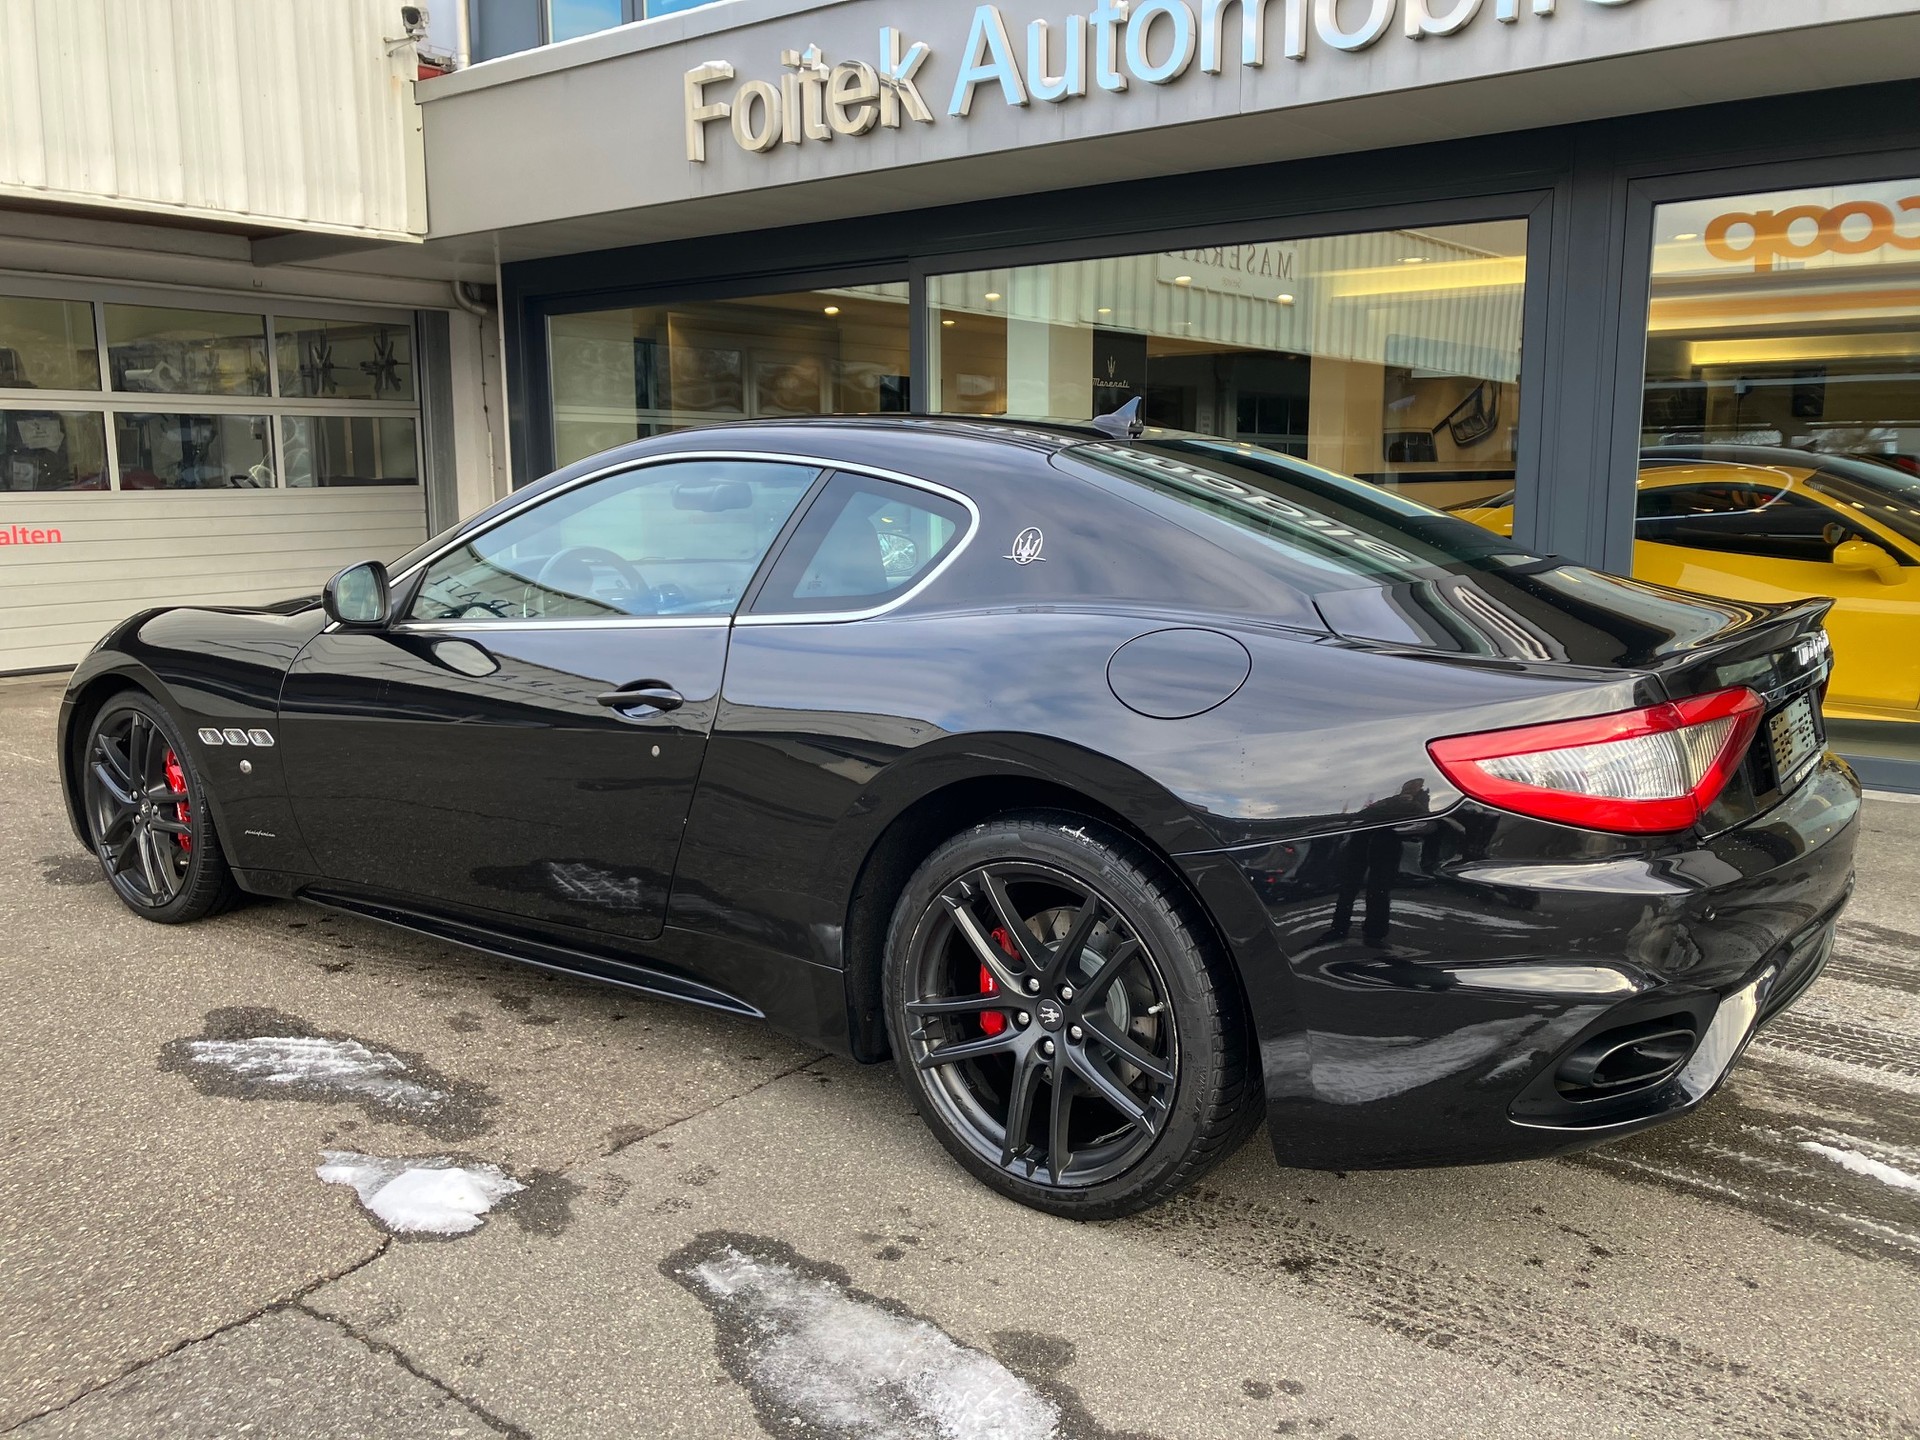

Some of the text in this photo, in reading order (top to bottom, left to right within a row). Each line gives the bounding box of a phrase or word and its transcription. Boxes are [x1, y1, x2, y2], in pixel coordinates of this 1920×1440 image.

[684, 0, 1637, 163] Foitek Automo
[0, 525, 62, 546] alten
